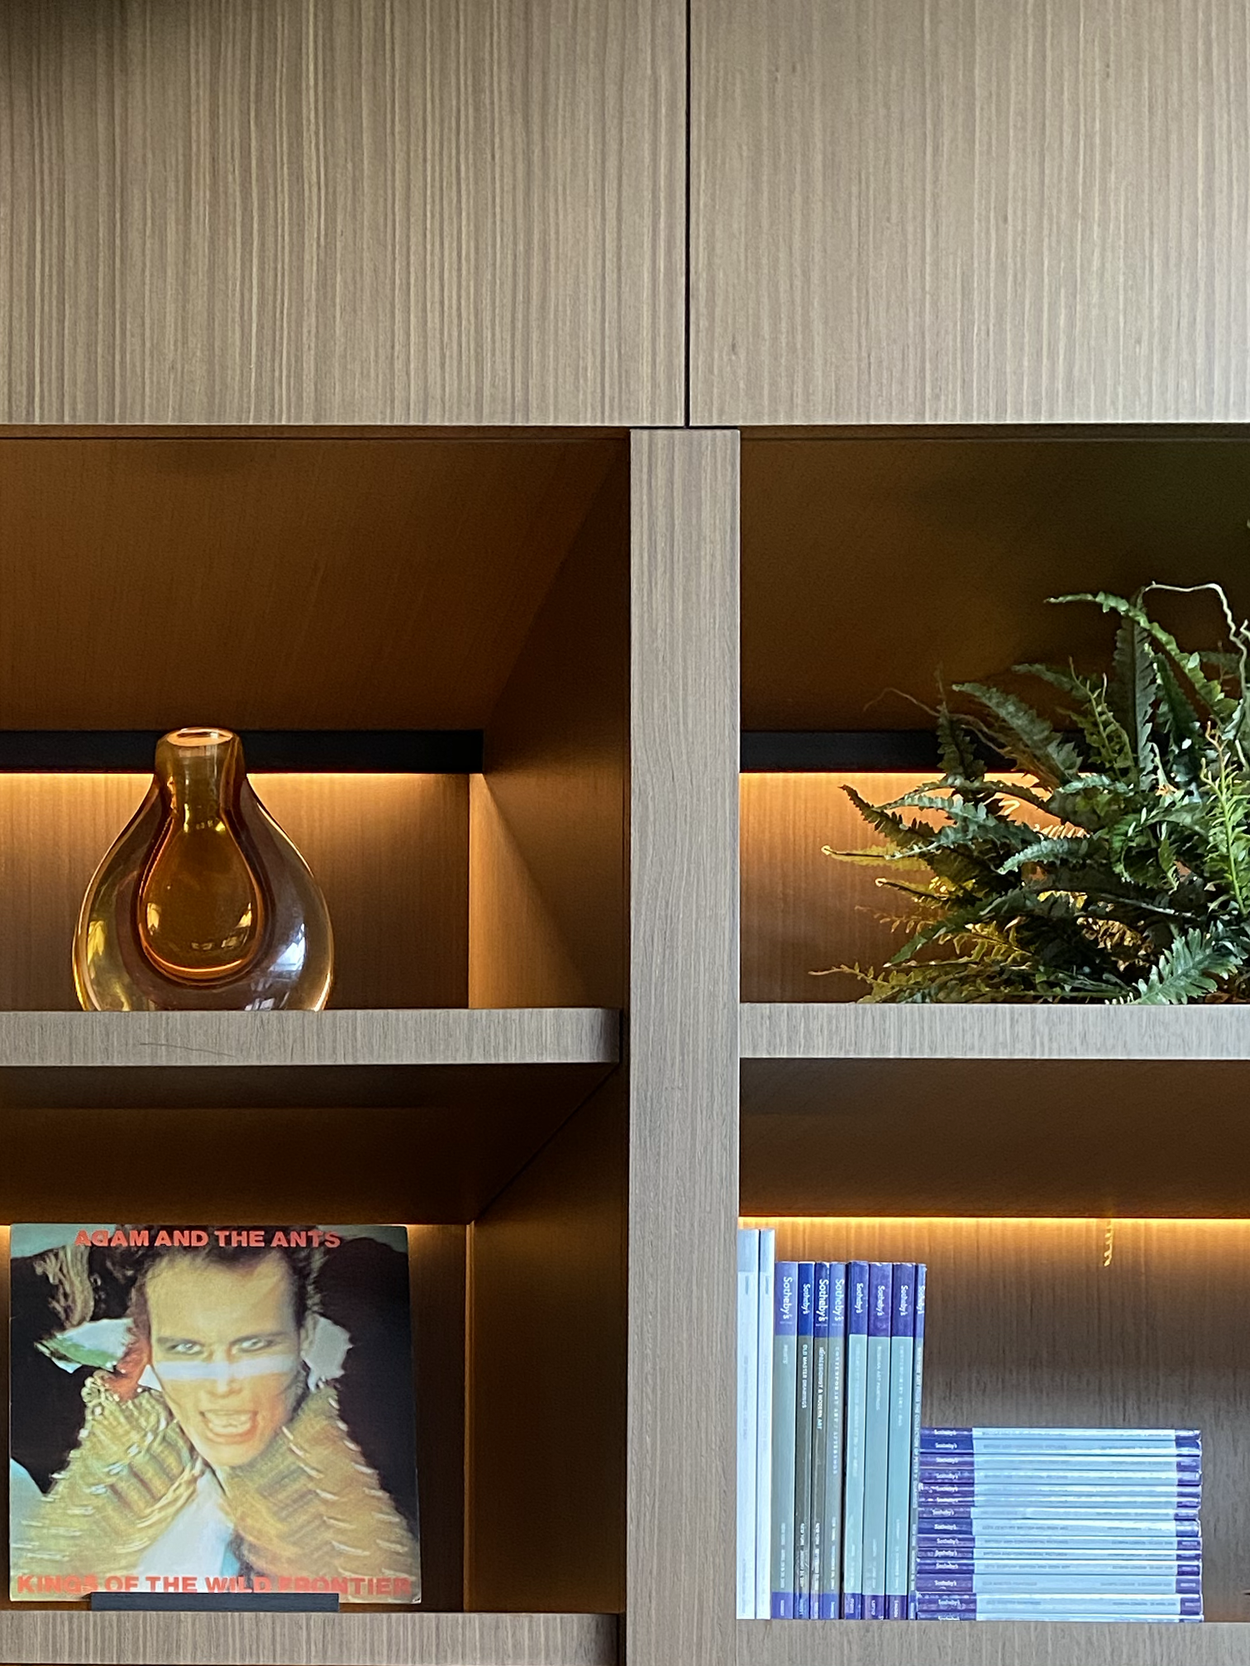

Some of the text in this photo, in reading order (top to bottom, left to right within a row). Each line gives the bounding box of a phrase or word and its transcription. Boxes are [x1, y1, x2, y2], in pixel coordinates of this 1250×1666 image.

[75, 1230, 341, 1247] ADAM AND THE ANTS
[781, 1277, 793, 1319] Sotheby's
[816, 1279, 829, 1322] Sotheby's
[833, 1279, 844, 1321] Sotheby's
[854, 1283, 864, 1314] Sotheby's
[876, 1286, 885, 1316] Sotheby's
[899, 1285, 908, 1315] Sotheby's
[16, 1575, 411, 1596] KINGS OF THE WILD FRONTIER
